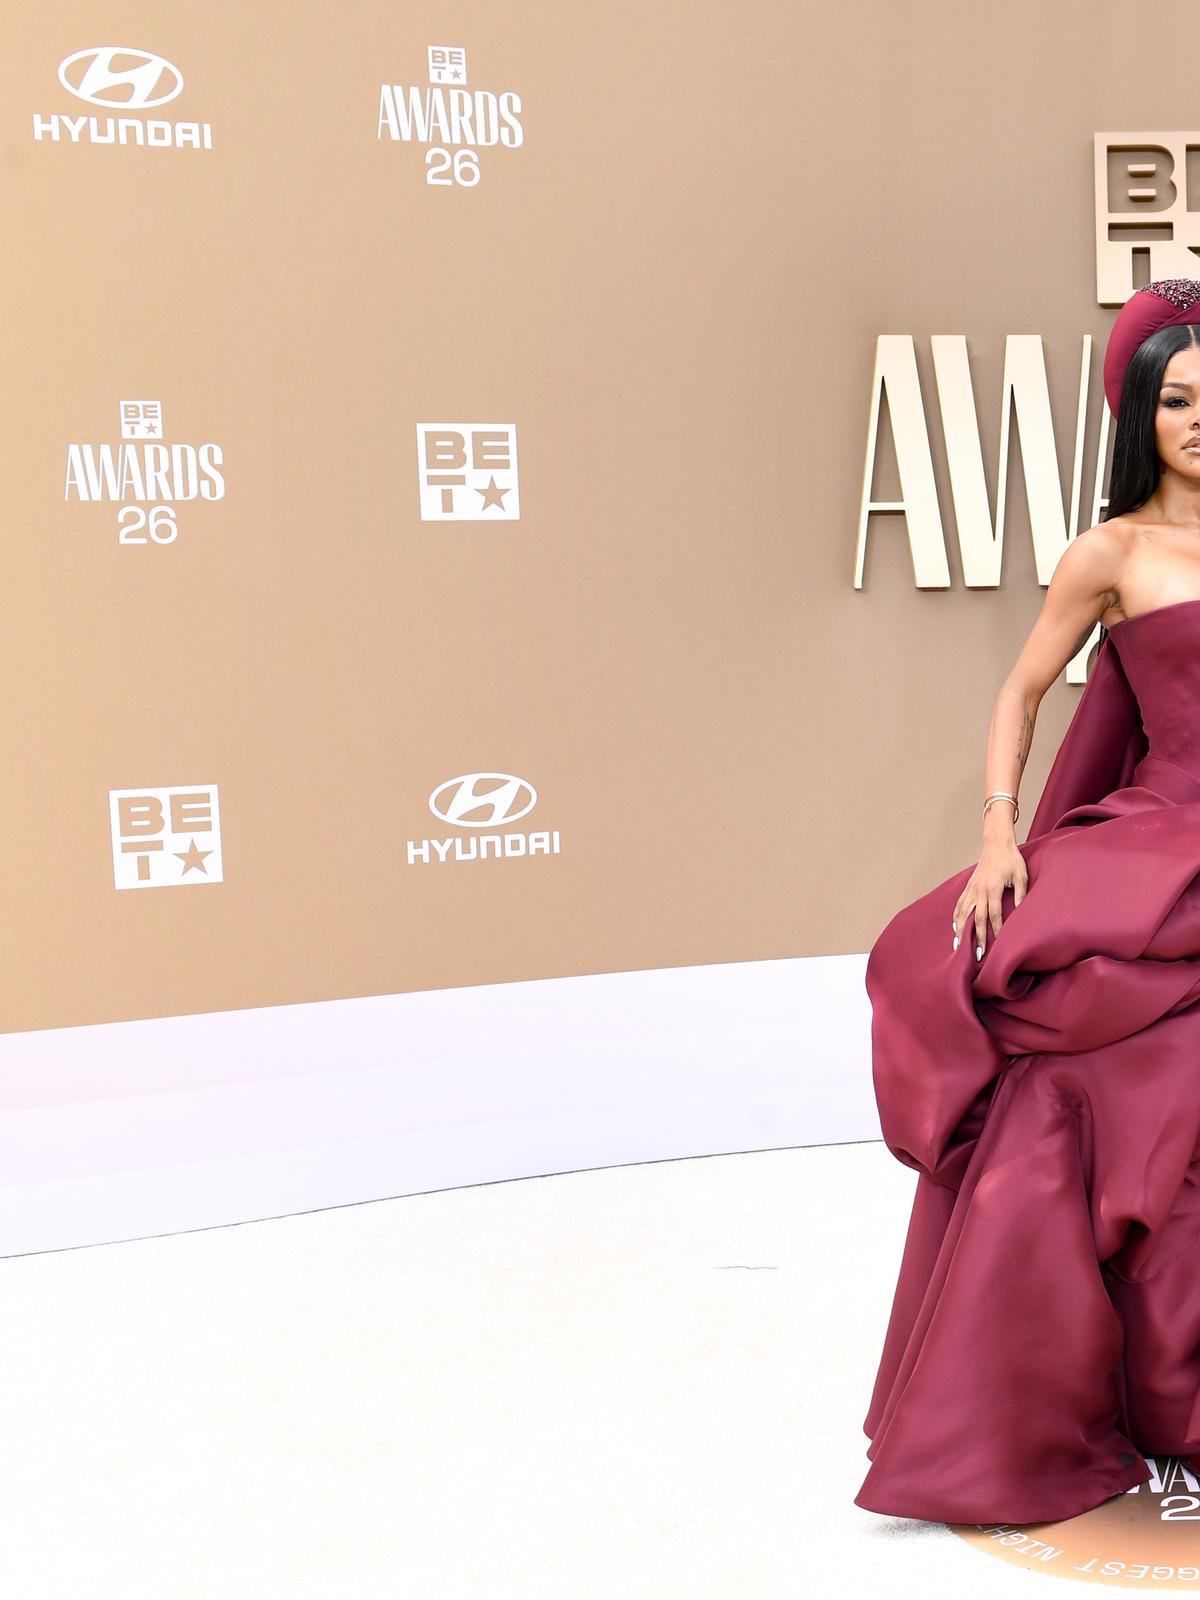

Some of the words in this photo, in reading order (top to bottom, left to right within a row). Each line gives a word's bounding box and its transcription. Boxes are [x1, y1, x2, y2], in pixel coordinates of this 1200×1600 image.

[33, 113, 212, 149] HYUNDAI
[377, 84, 524, 148] AWARDS
[425, 147, 481, 187] 26
[64, 443, 225, 501] AWARDS
[117, 505, 178, 545] 26
[407, 831, 560, 864] HYUNDAI
[976, 1524, 1064, 1562] NIGH
